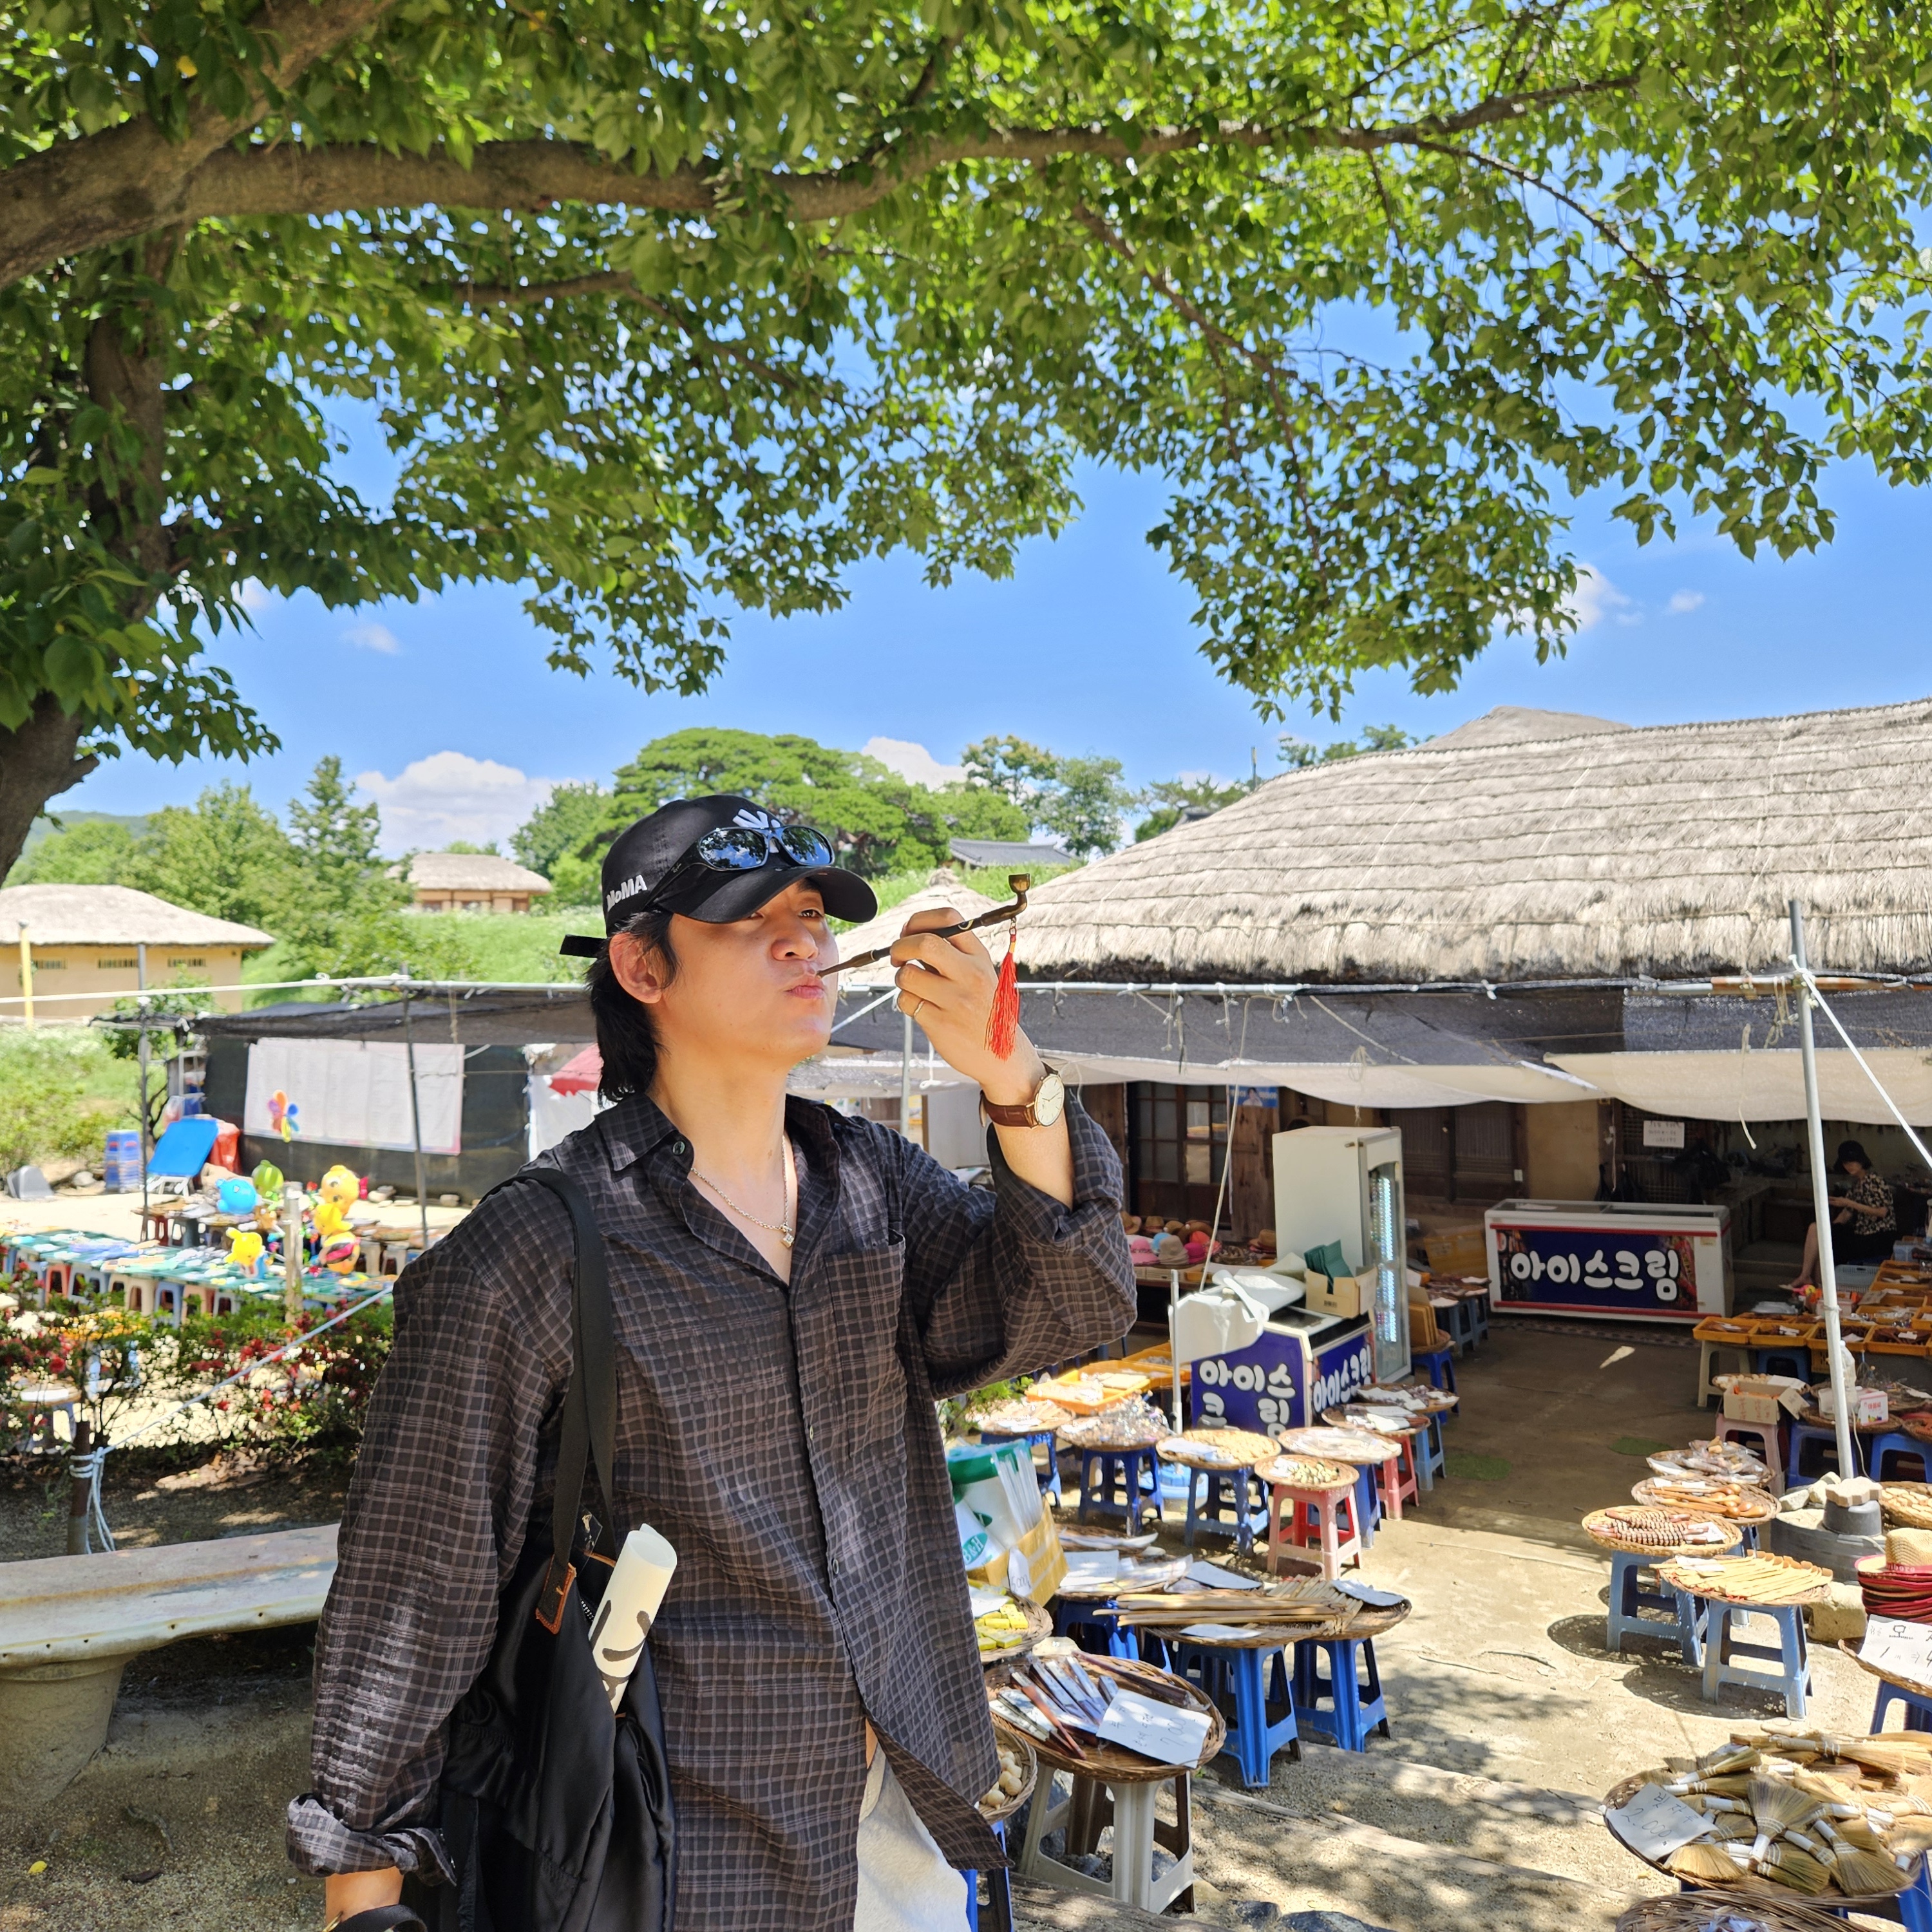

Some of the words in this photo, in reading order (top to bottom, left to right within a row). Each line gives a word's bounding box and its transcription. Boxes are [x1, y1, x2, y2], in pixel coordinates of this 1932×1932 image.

[1510, 1249, 1679, 1301] 아이스크림
[1199, 1359, 1296, 1399] 아이스
[1653, 1792, 1699, 1824] 빗자루
